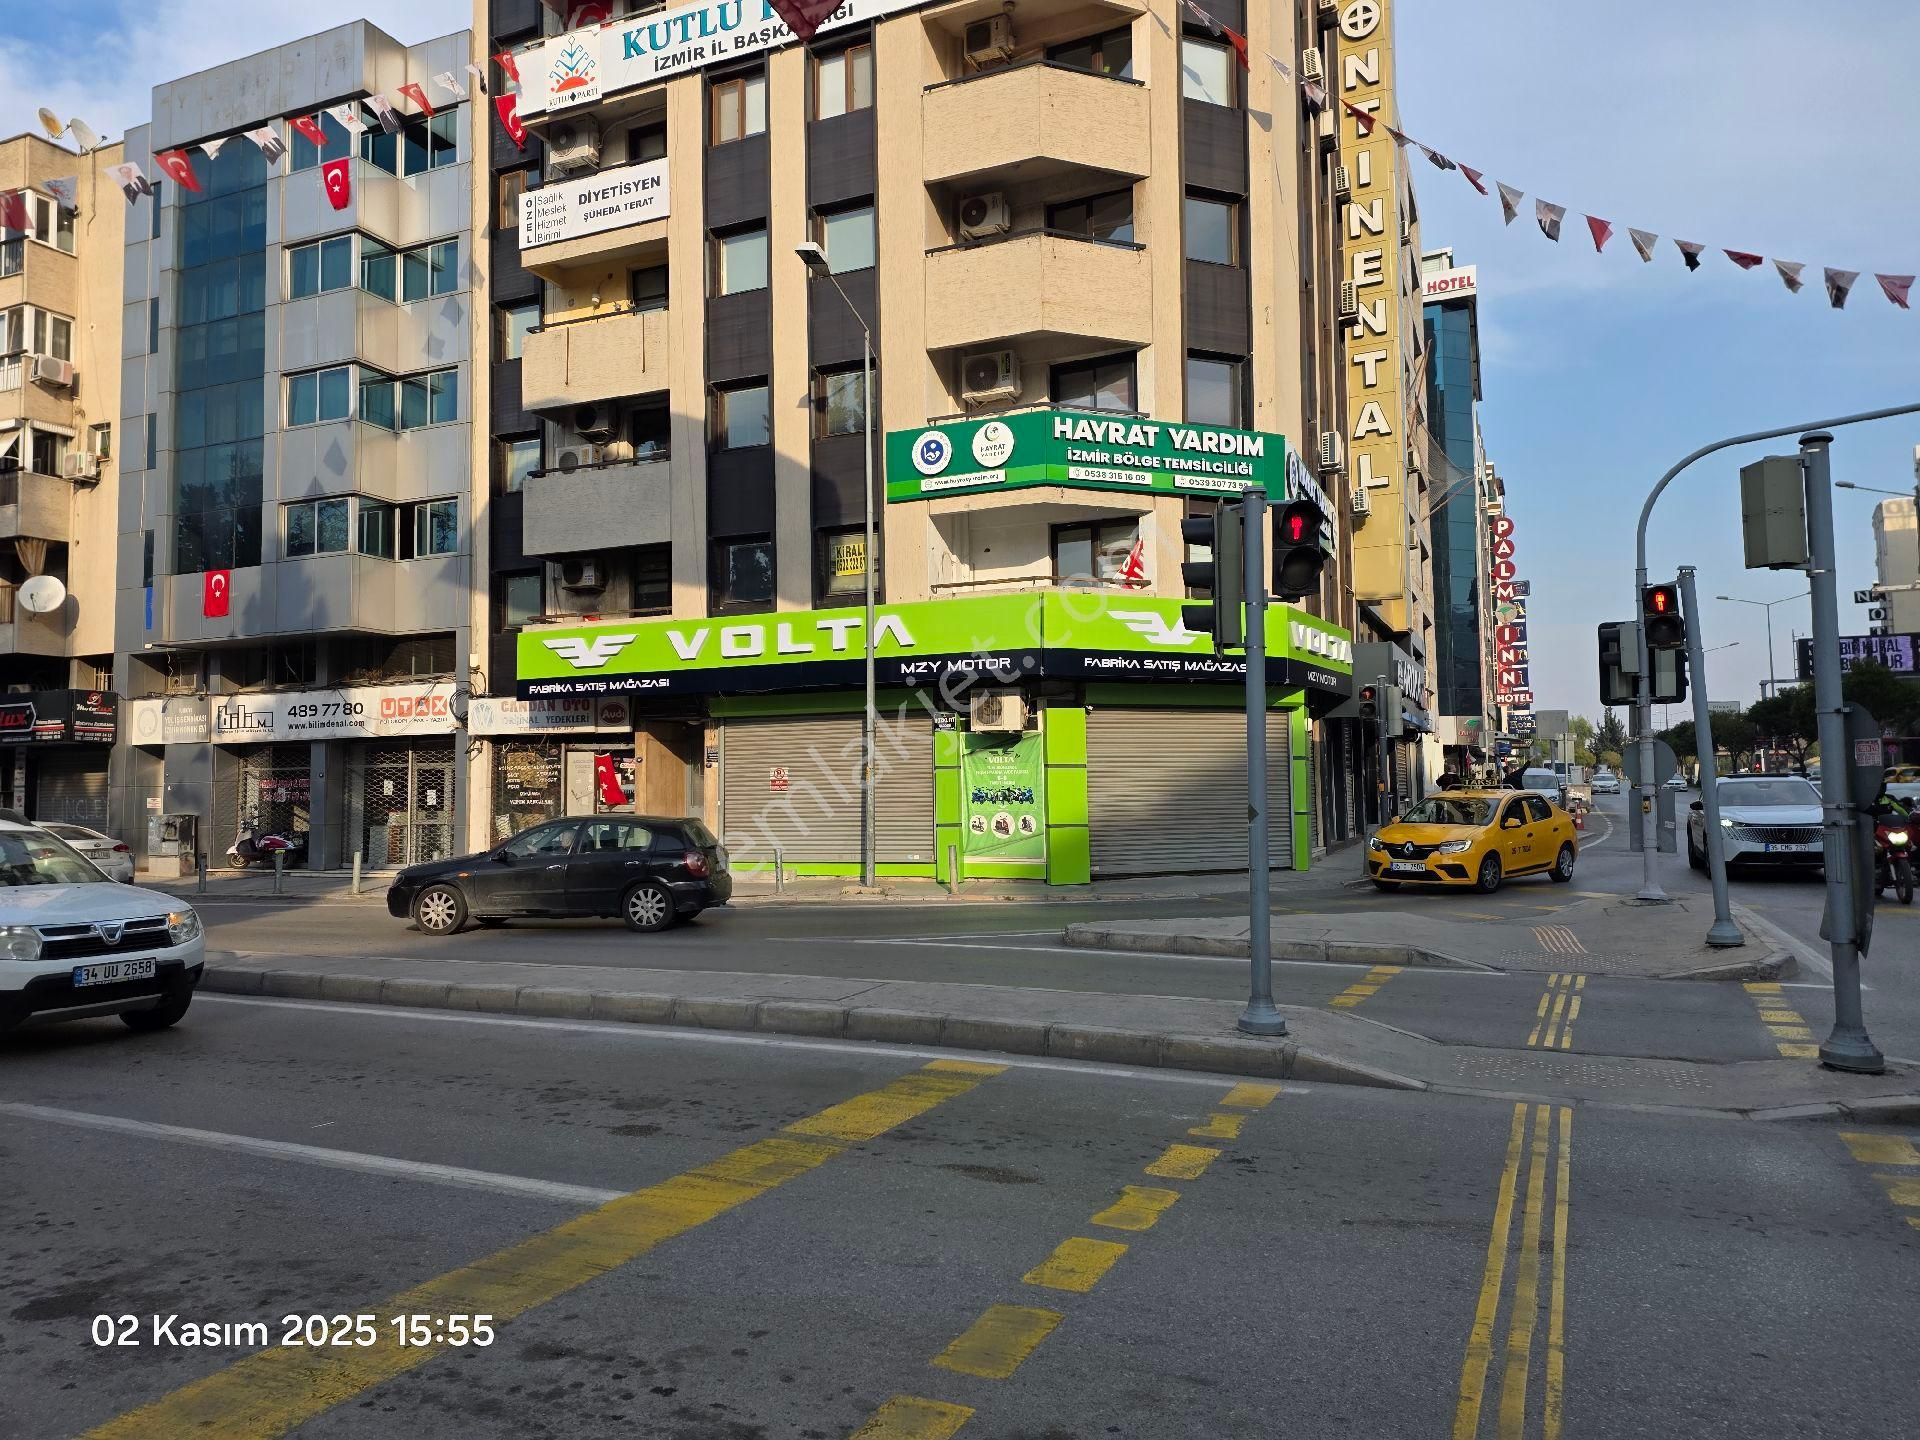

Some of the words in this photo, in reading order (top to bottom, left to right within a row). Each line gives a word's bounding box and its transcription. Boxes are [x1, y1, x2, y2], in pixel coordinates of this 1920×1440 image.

[623, 0, 744, 60] KUTLU
[654, 46, 705, 72] İZMİR
[711, 39, 729, 56] İL
[537, 191, 564, 206] Sağlık
[578, 175, 661, 205] DİYETİSYEN
[537, 203, 567, 218] Meslek
[583, 205, 621, 223] ŞÜHEDA
[624, 196, 654, 211] TERAT
[537, 216, 567, 230] Hizmet
[537, 229, 561, 243] Birimi
[1427, 275, 1475, 293] HOTEL
[1053, 416, 1159, 448] HAYRAT
[1168, 428, 1265, 458] YARDIM
[1067, 446, 1110, 465] İZMİR
[1113, 451, 1161, 469] BÖLGE
[1163, 457, 1253, 476] TEMSİLCİLİĞİ
[1124, 472, 1134, 481] 16
[1135, 474, 1146, 482] 09
[1189, 478, 1210, 487] 0539
[1228, 481, 1238, 489] 73
[836, 544, 869, 559] KİRALI
[666, 614, 917, 660] VOLTA
[1289, 621, 1354, 664] VOLTA
[901, 661, 940, 674] MZY
[948, 656, 1011, 671] MOTOR
[1085, 656, 1140, 670] FABRİKA
[1143, 659, 1181, 673] SATIŞ
[1185, 659, 1248, 674] MAĞAZAS
[528, 681, 573, 695] FABRİKA
[575, 681, 607, 693] SATIŞ
[609, 678, 670, 691] MAĞAZASI
[500, 699, 556, 713] CANDAN
[562, 699, 590, 712] OTO
[1496, 692, 1533, 704] HOTEL
[288, 704, 318, 718] 489
[382, 697, 446, 717] UTAX
[602, 709, 625, 719] Audi
[546, 711, 590, 725] YEDEKLERİ
[83, 967, 98, 981] 34
[103, 964, 119, 979] UU
[123, 960, 152, 977] 2658
